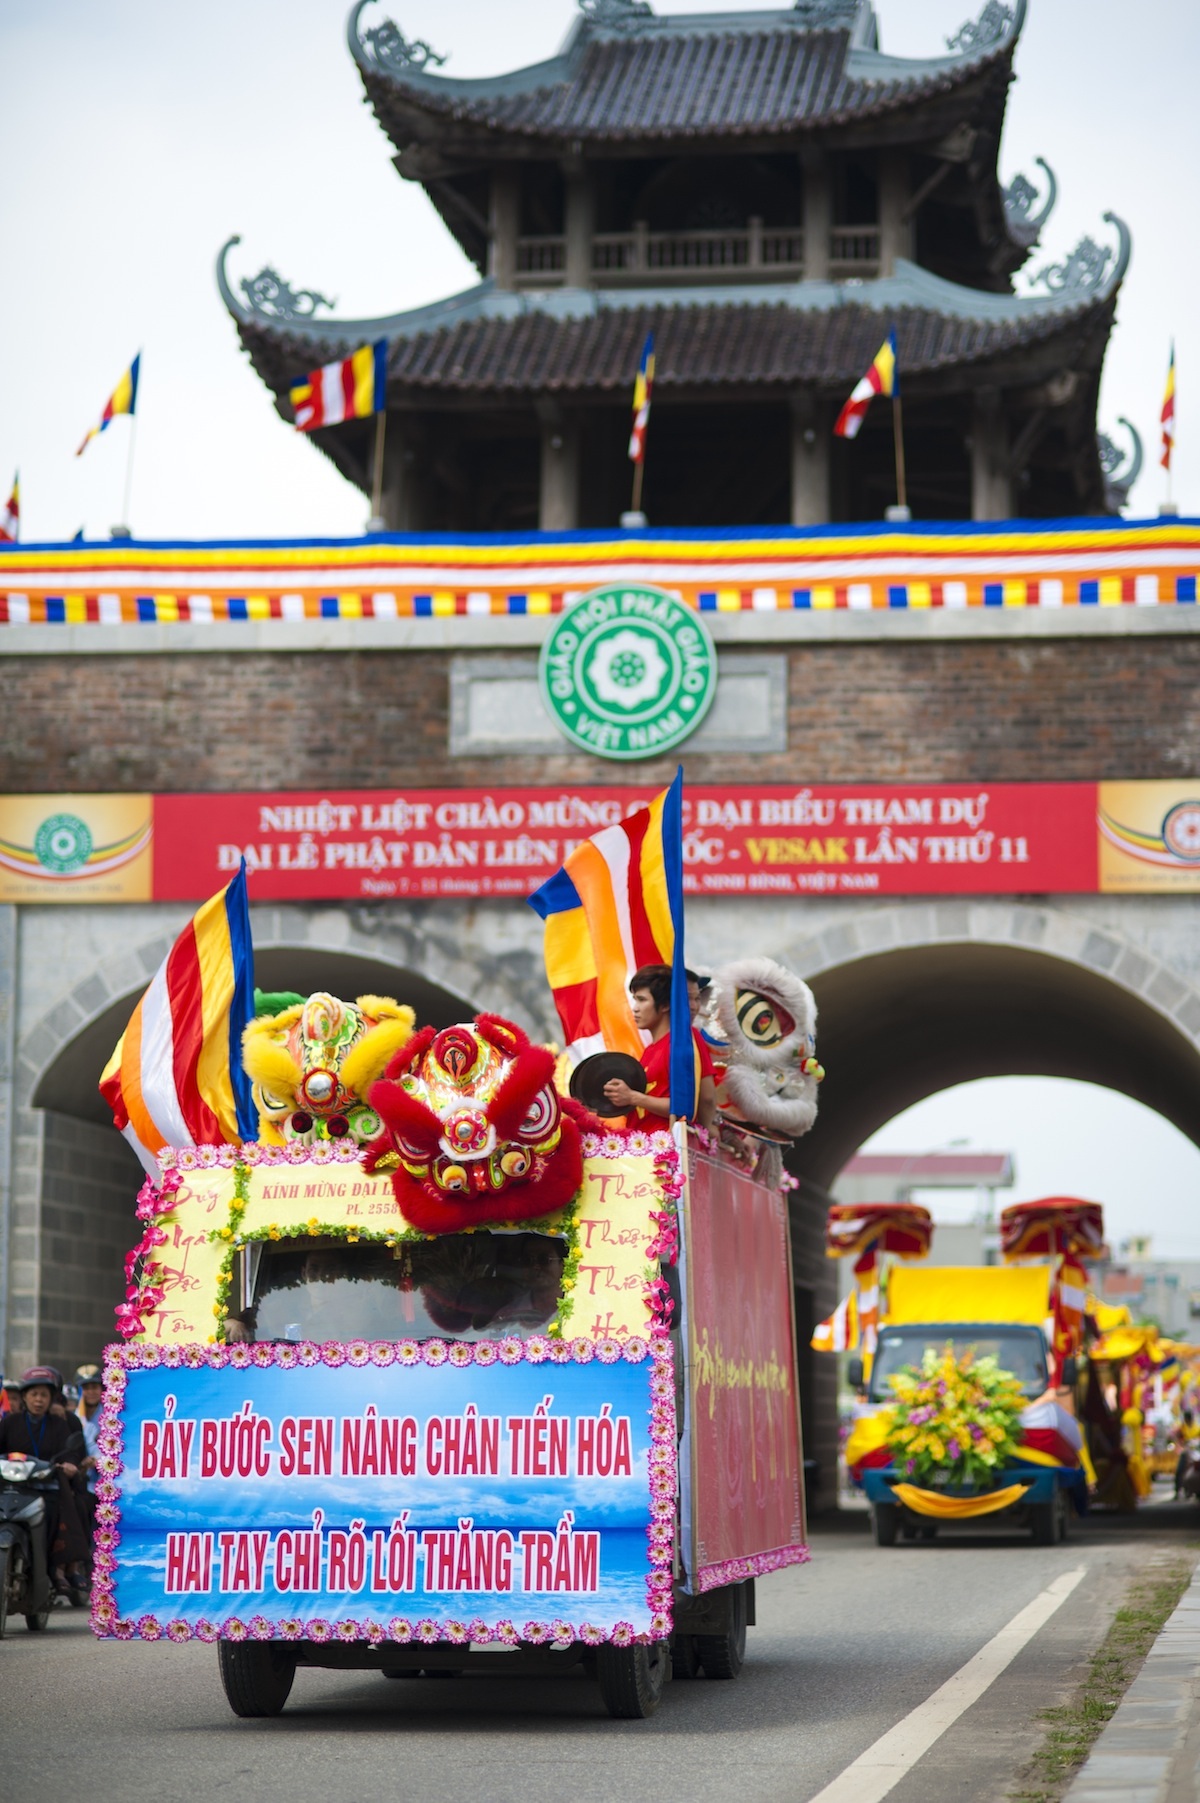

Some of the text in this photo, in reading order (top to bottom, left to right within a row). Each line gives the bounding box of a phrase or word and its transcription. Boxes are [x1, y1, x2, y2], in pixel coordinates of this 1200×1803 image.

[627, 710, 685, 749] NAM
[260, 800, 356, 835] NHIỆT
[361, 798, 432, 835] LIỆT
[435, 797, 524, 828] CHÀO
[528, 796, 621, 828] MỪNG
[840, 798, 933, 826] THAM
[939, 793, 989, 828] DỰ
[324, 837, 407, 873] PHẬT
[484, 834, 557, 867] LIÊN
[745, 838, 848, 864] VESAK
[853, 827, 917, 863] LẦN
[924, 831, 994, 863] THỨ
[999, 838, 1029, 862] 11
[262, 1182, 300, 1199] KÍNH
[303, 1181, 346, 1197] MỪNG
[351, 1182, 378, 1198] ĐẠI
[588, 1173, 661, 1203] Thiên
[346, 1203, 398, 1215] PL. 2558
[146, 1310, 196, 1338] Tôn
[591, 1311, 630, 1341] Hạ
[141, 1394, 633, 1479] BẢY BƯỚC SEN NÂNG CHÂN TIẾN HÓA
[165, 1508, 600, 1594] HAI TAY CHỈ RÕ LỐI THĂNG TRẦM
